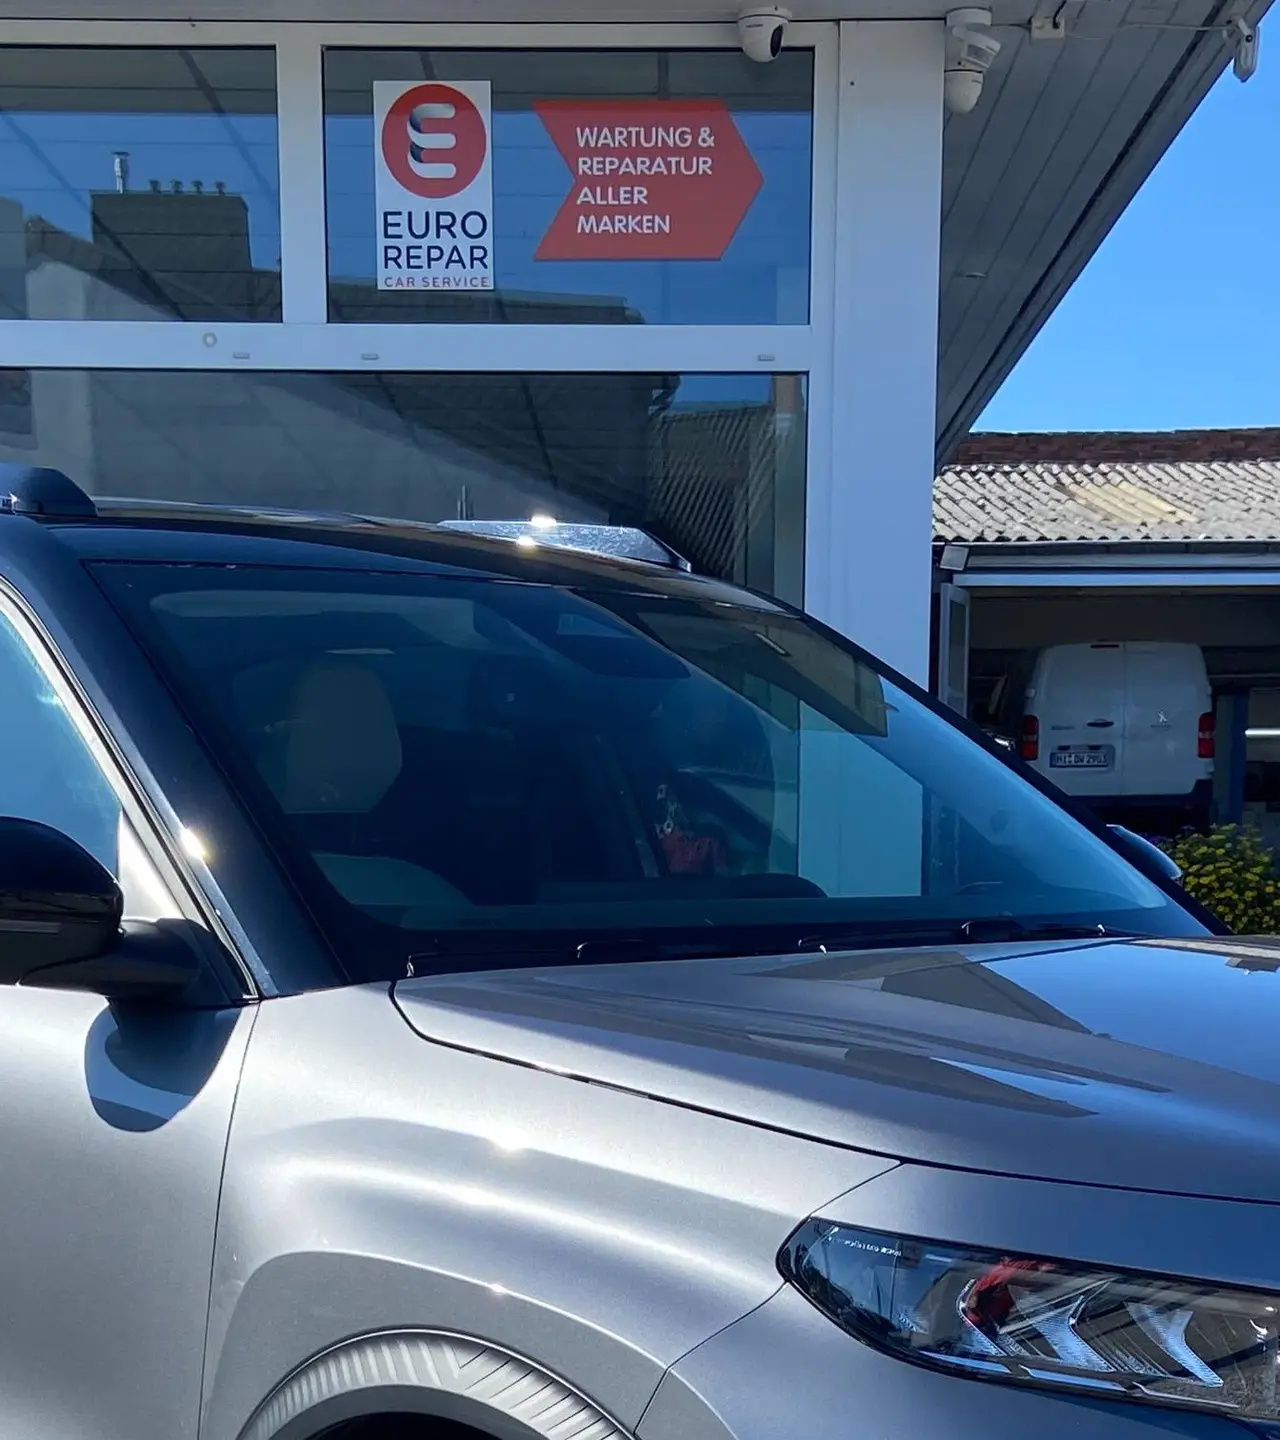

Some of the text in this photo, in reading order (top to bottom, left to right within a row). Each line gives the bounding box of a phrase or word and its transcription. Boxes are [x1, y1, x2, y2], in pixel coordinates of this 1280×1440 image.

[577, 127, 715, 148] WARTUNG &
[578, 157, 712, 176] REPARATUR
[577, 187, 648, 205] ALLER
[383, 210, 488, 239] EURO
[577, 215, 670, 234] MARKEN
[384, 245, 488, 270] REPAR
[384, 276, 489, 288] CAR SERVICE
